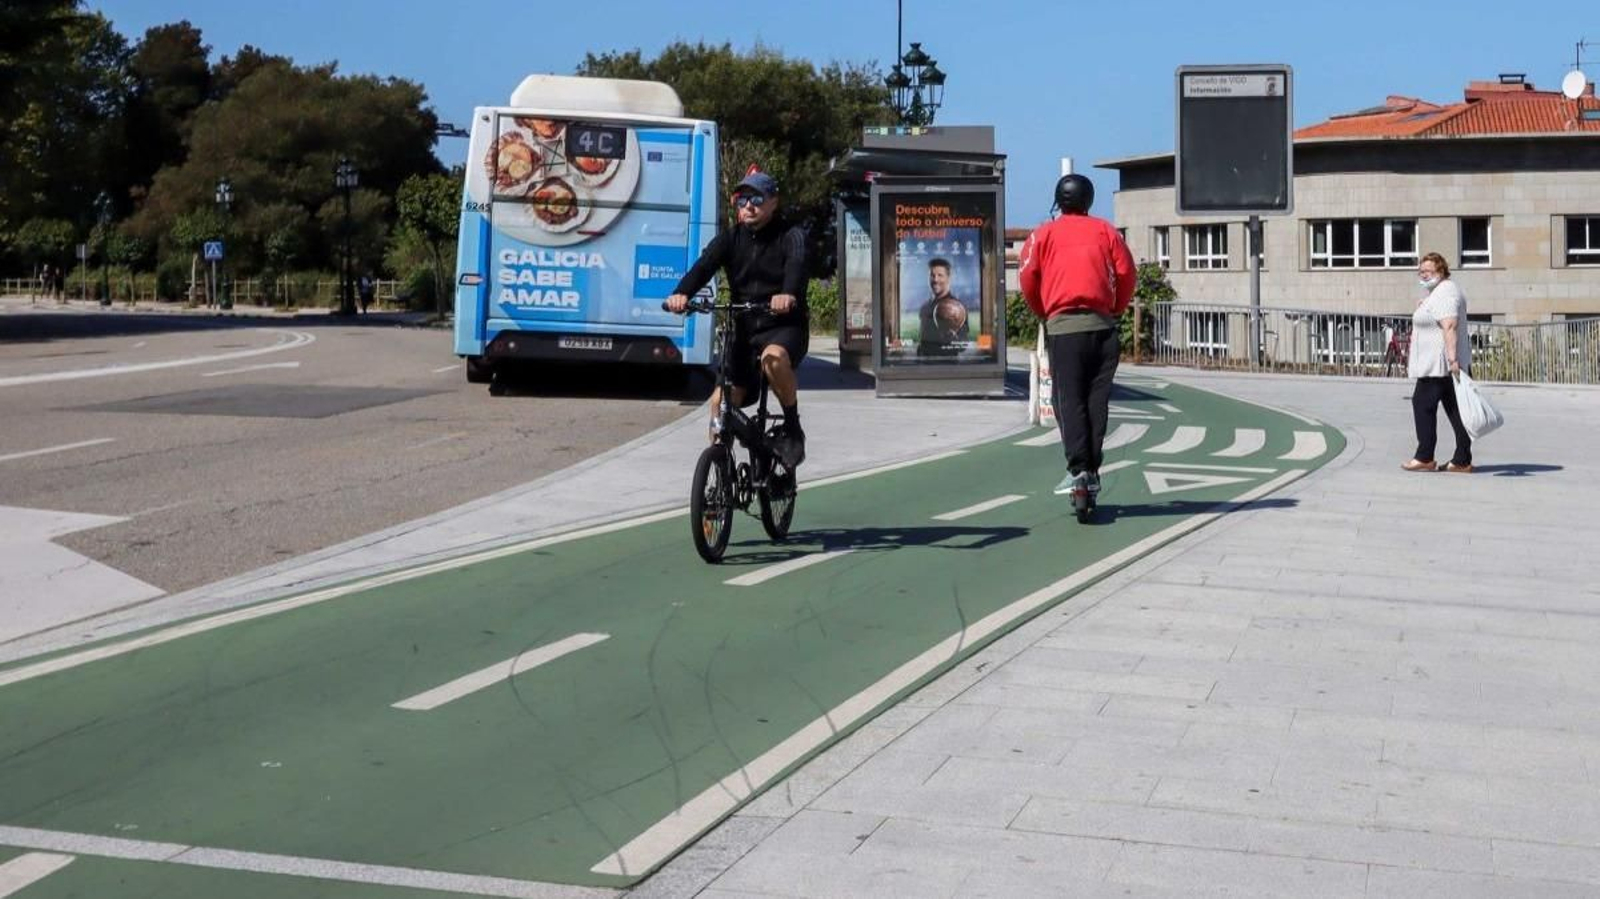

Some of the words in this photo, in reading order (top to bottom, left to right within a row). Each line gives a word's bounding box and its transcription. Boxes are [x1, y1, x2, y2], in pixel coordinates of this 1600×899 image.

[579, 131, 614, 153] 4C
[896, 204, 950, 215] Descubre
[896, 217, 921, 226] todo
[936, 217, 983, 226] universo
[499, 249, 605, 269] GALICIA
[499, 269, 573, 287] SABE
[498, 288, 580, 307] AMAR
